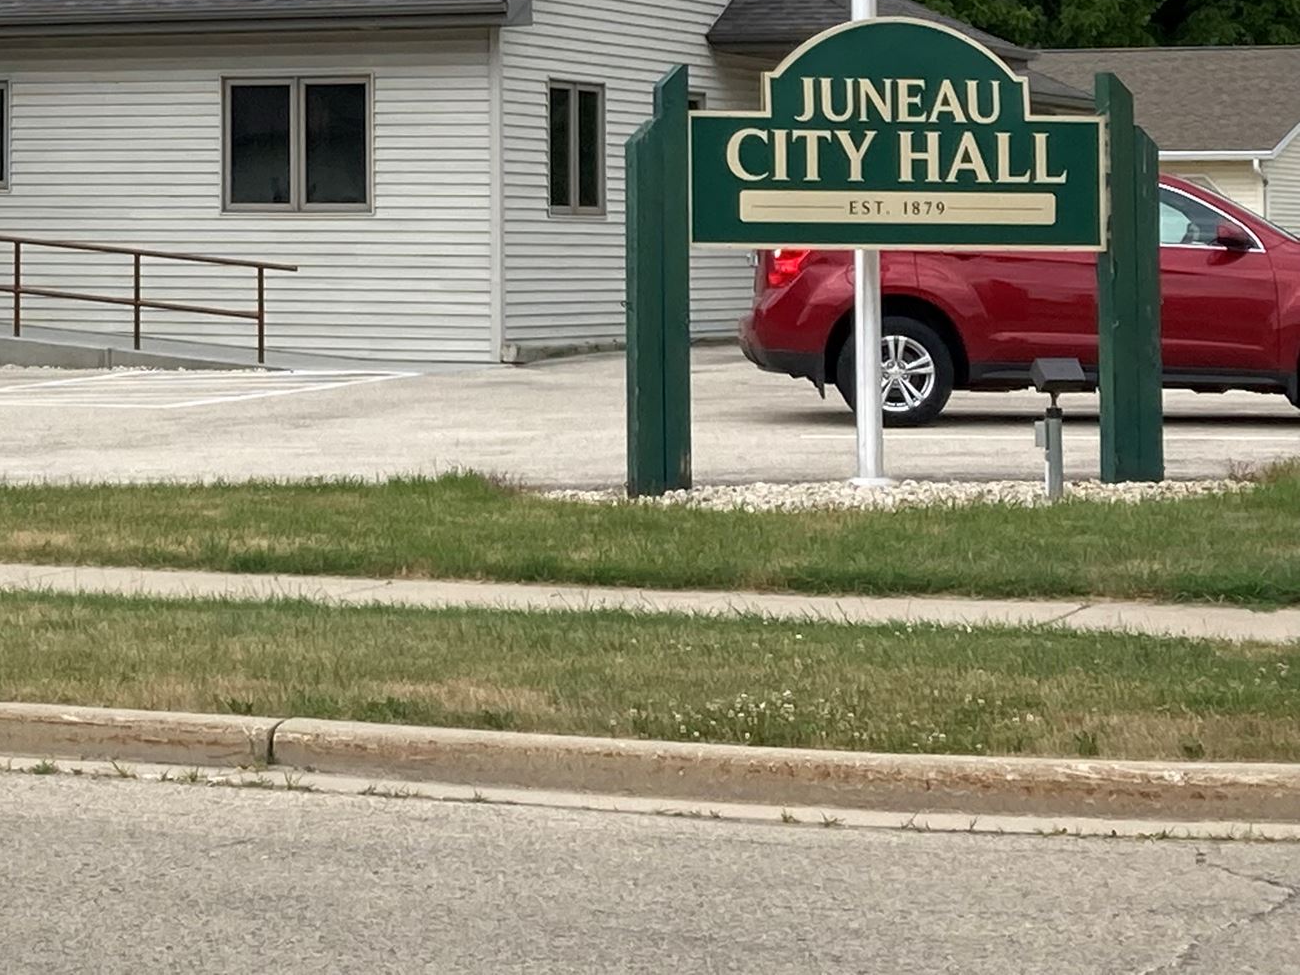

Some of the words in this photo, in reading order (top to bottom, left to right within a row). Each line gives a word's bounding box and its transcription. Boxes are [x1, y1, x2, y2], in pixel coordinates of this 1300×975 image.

[793, 76, 1000, 124] JUNEAU
[725, 128, 878, 182] CITY
[897, 130, 1068, 184] HALL
[848, 200, 891, 216] EST.
[902, 200, 946, 216] 1879
